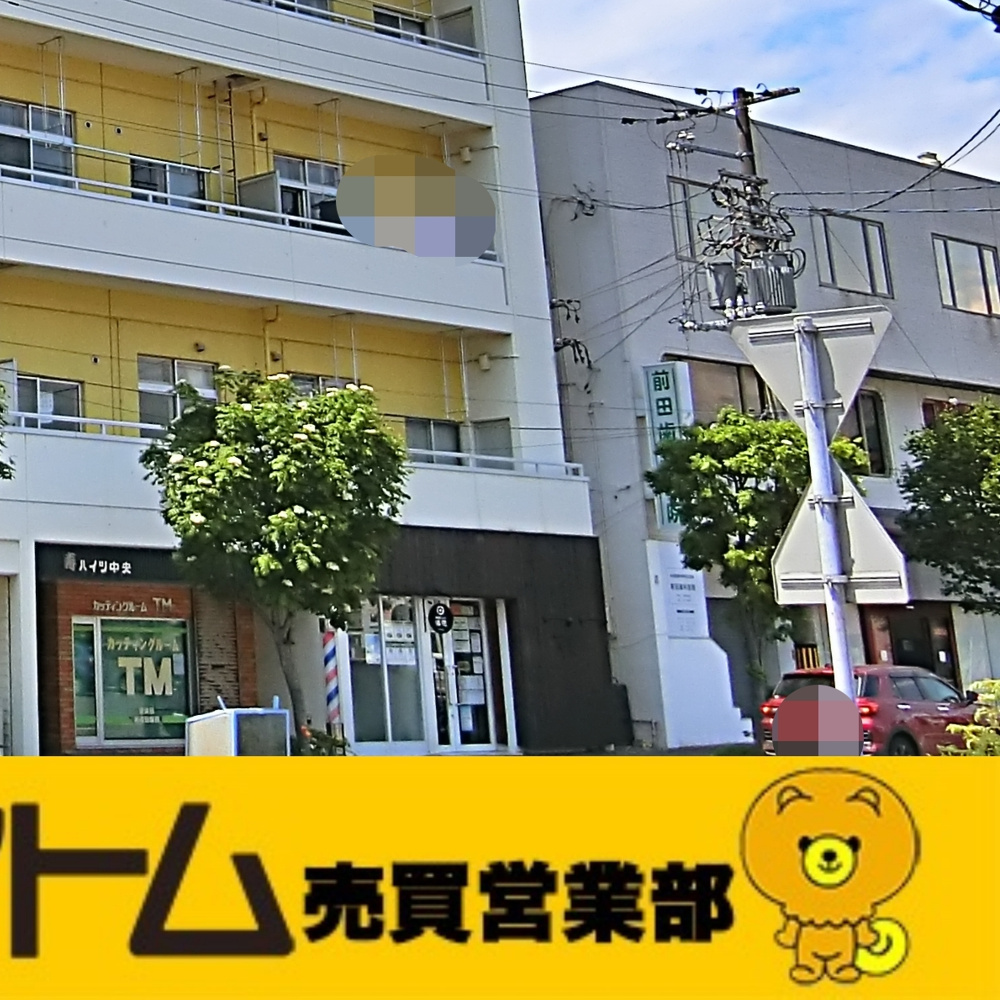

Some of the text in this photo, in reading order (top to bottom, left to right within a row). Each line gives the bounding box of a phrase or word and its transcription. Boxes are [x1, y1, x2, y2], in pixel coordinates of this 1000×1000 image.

[652, 370, 683, 525] 前田歯院
[152, 597, 173, 612] TM
[117, 656, 173, 696] TM
